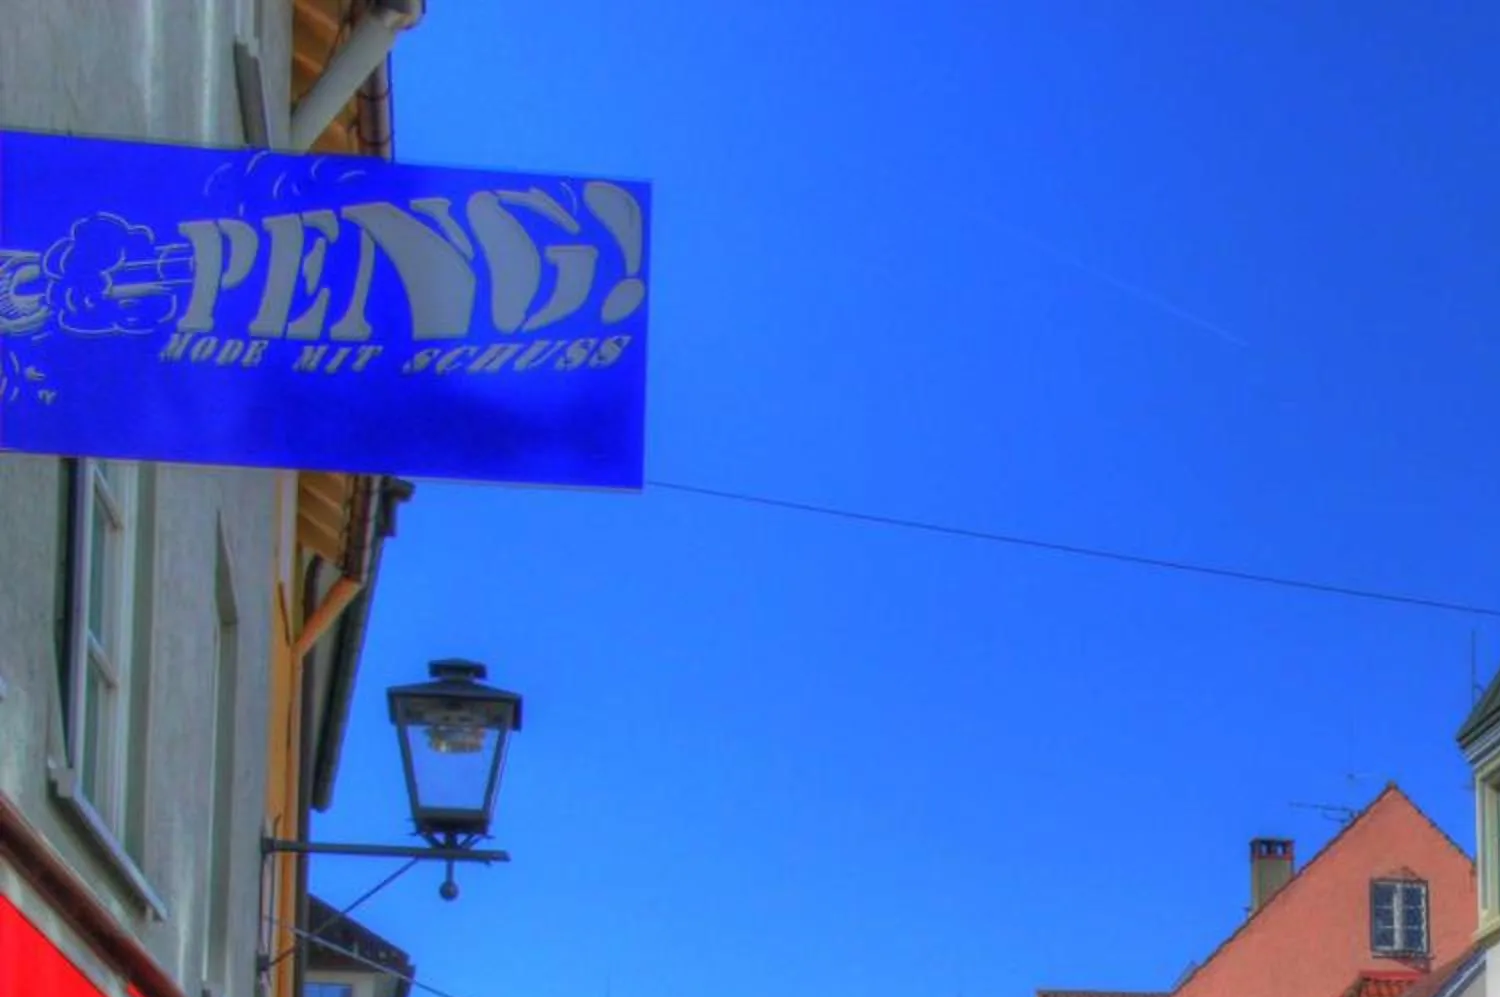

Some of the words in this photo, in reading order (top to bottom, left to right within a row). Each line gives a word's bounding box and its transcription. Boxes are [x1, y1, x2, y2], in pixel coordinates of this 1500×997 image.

[177, 180, 647, 341] PENG!
[159, 332, 269, 369] MODE
[292, 344, 383, 374] MIT
[402, 334, 632, 376] SCHUSS
